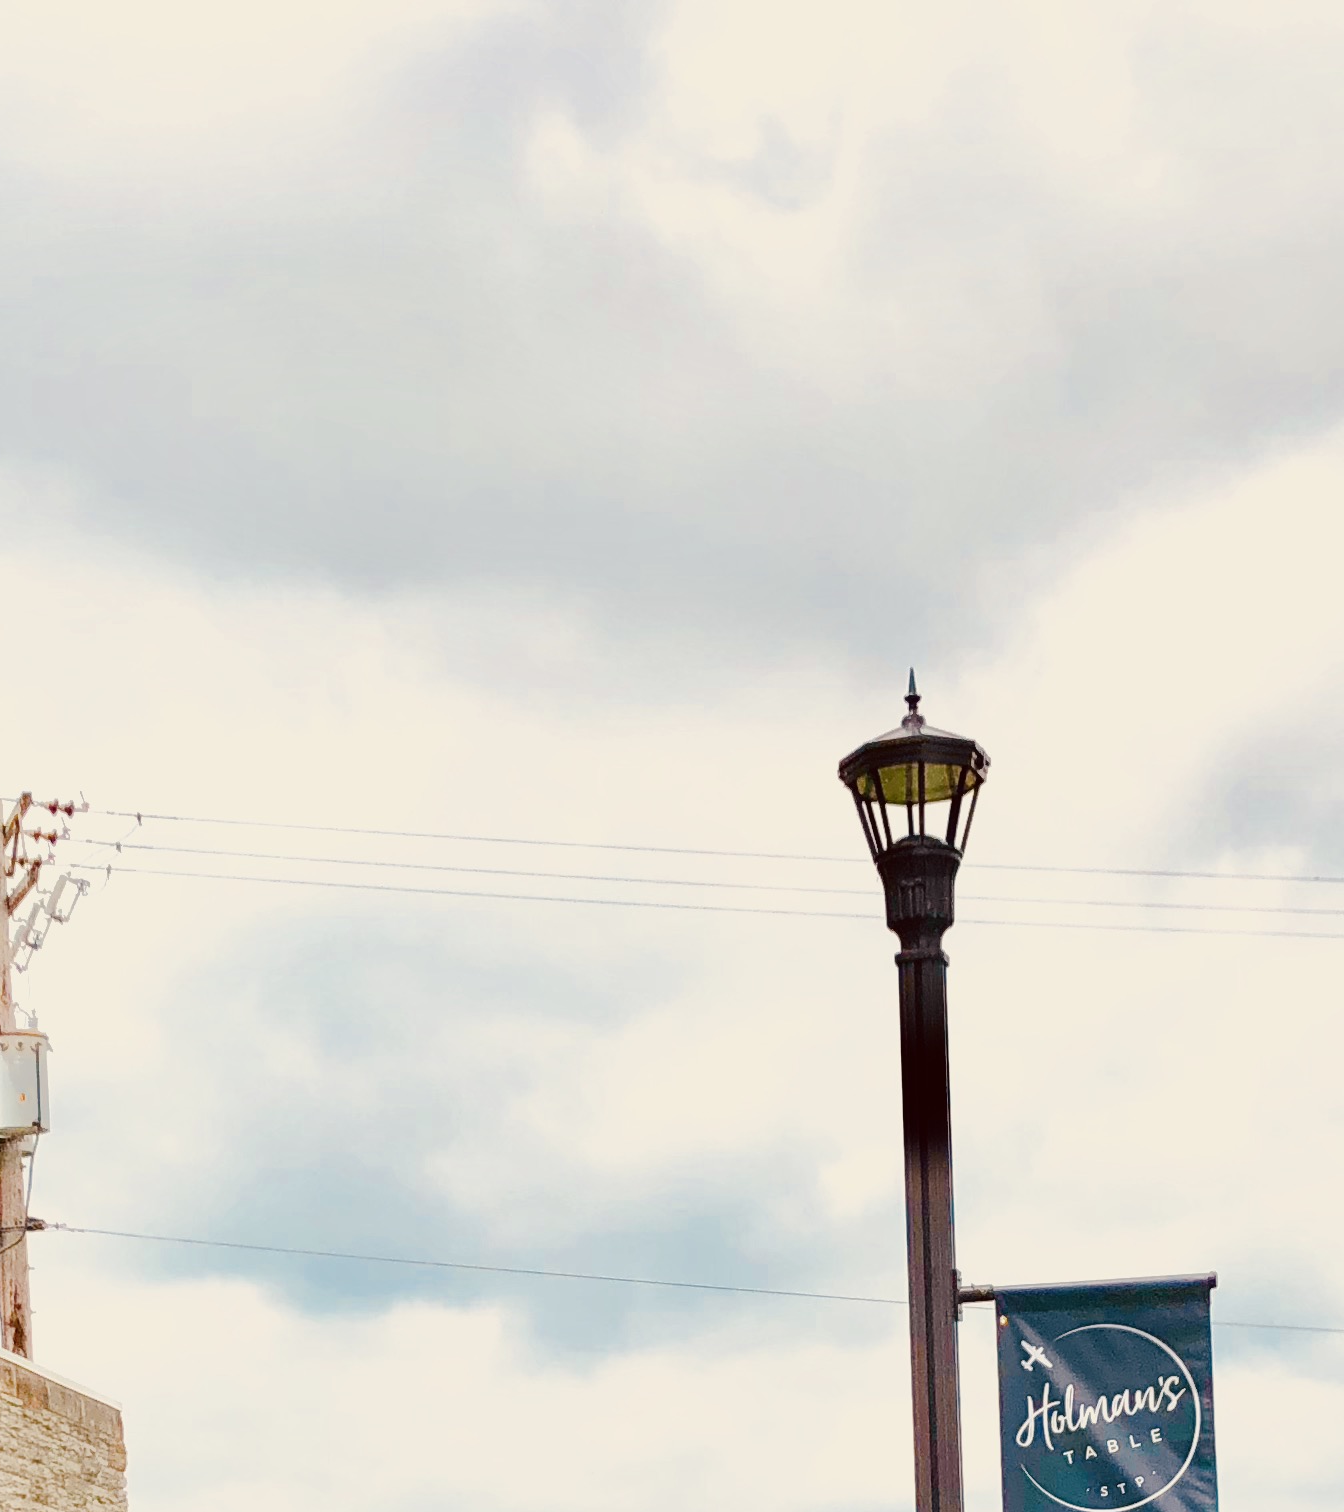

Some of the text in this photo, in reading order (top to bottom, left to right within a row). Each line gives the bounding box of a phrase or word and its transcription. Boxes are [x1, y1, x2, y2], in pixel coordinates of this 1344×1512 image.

[1015, 1375, 1187, 1451] Holman's
[1062, 1427, 1163, 1465] TABLE
[1100, 1475, 1145, 1497] STP
